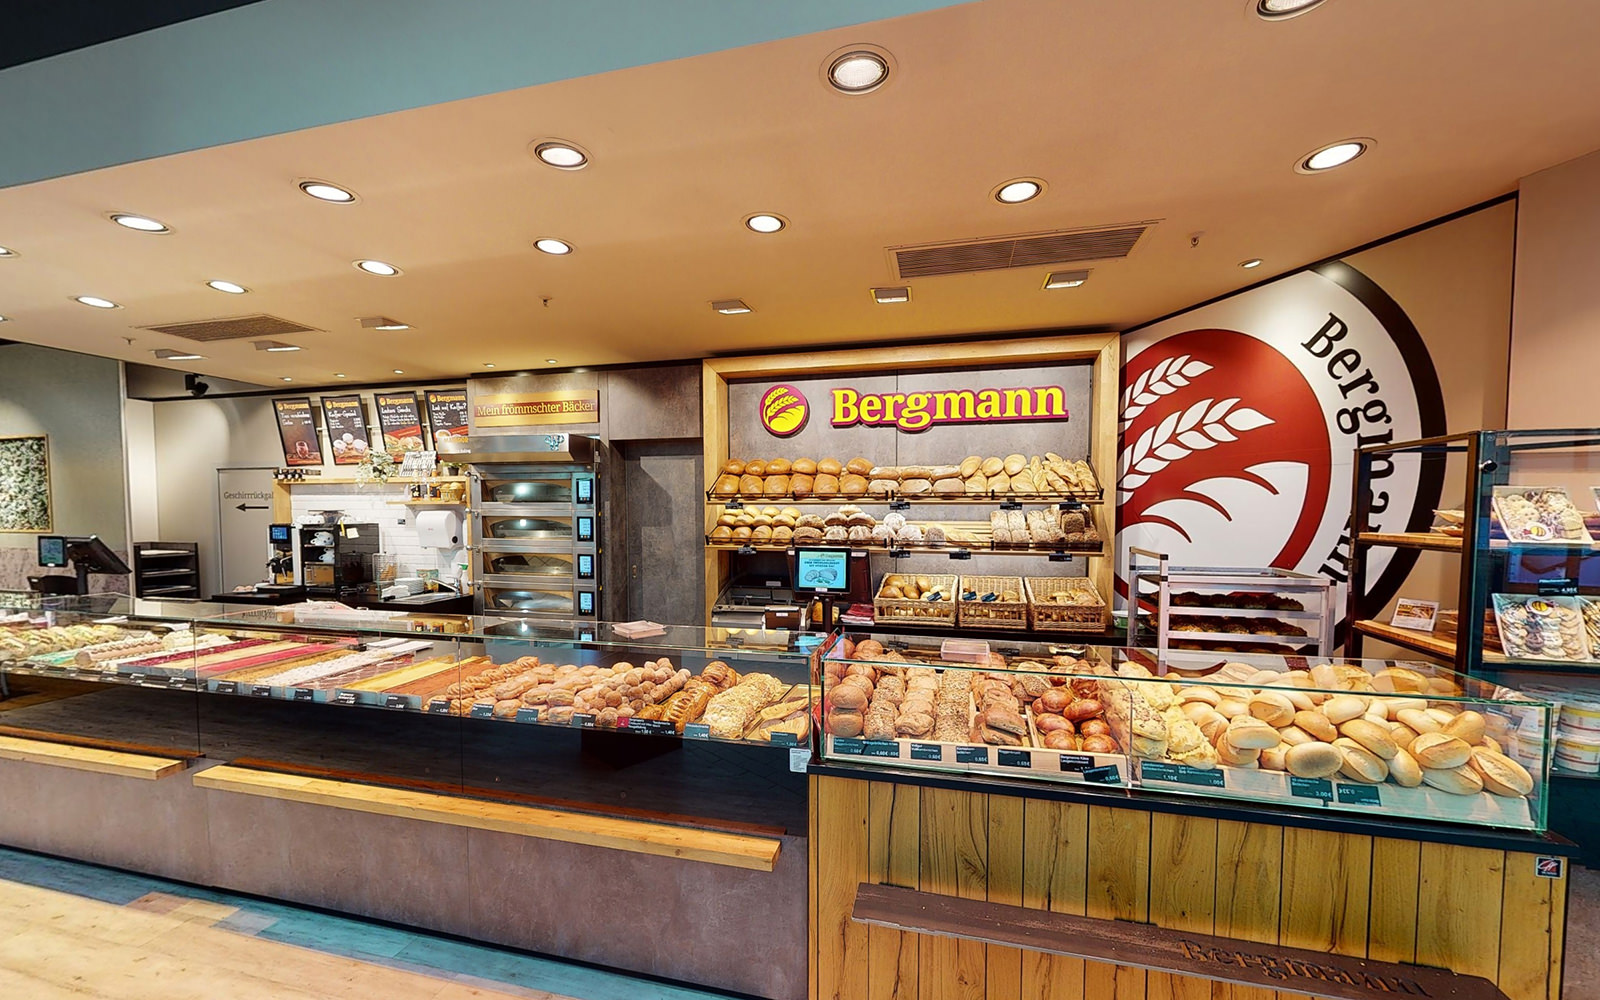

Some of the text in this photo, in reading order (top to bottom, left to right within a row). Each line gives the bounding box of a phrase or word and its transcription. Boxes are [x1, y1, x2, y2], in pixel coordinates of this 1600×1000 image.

[477, 400, 596, 416] Mein frömmschter Bäcker
[832, 386, 1067, 429] Bergmann
[1178, 939, 1433, 998] Bergmann
